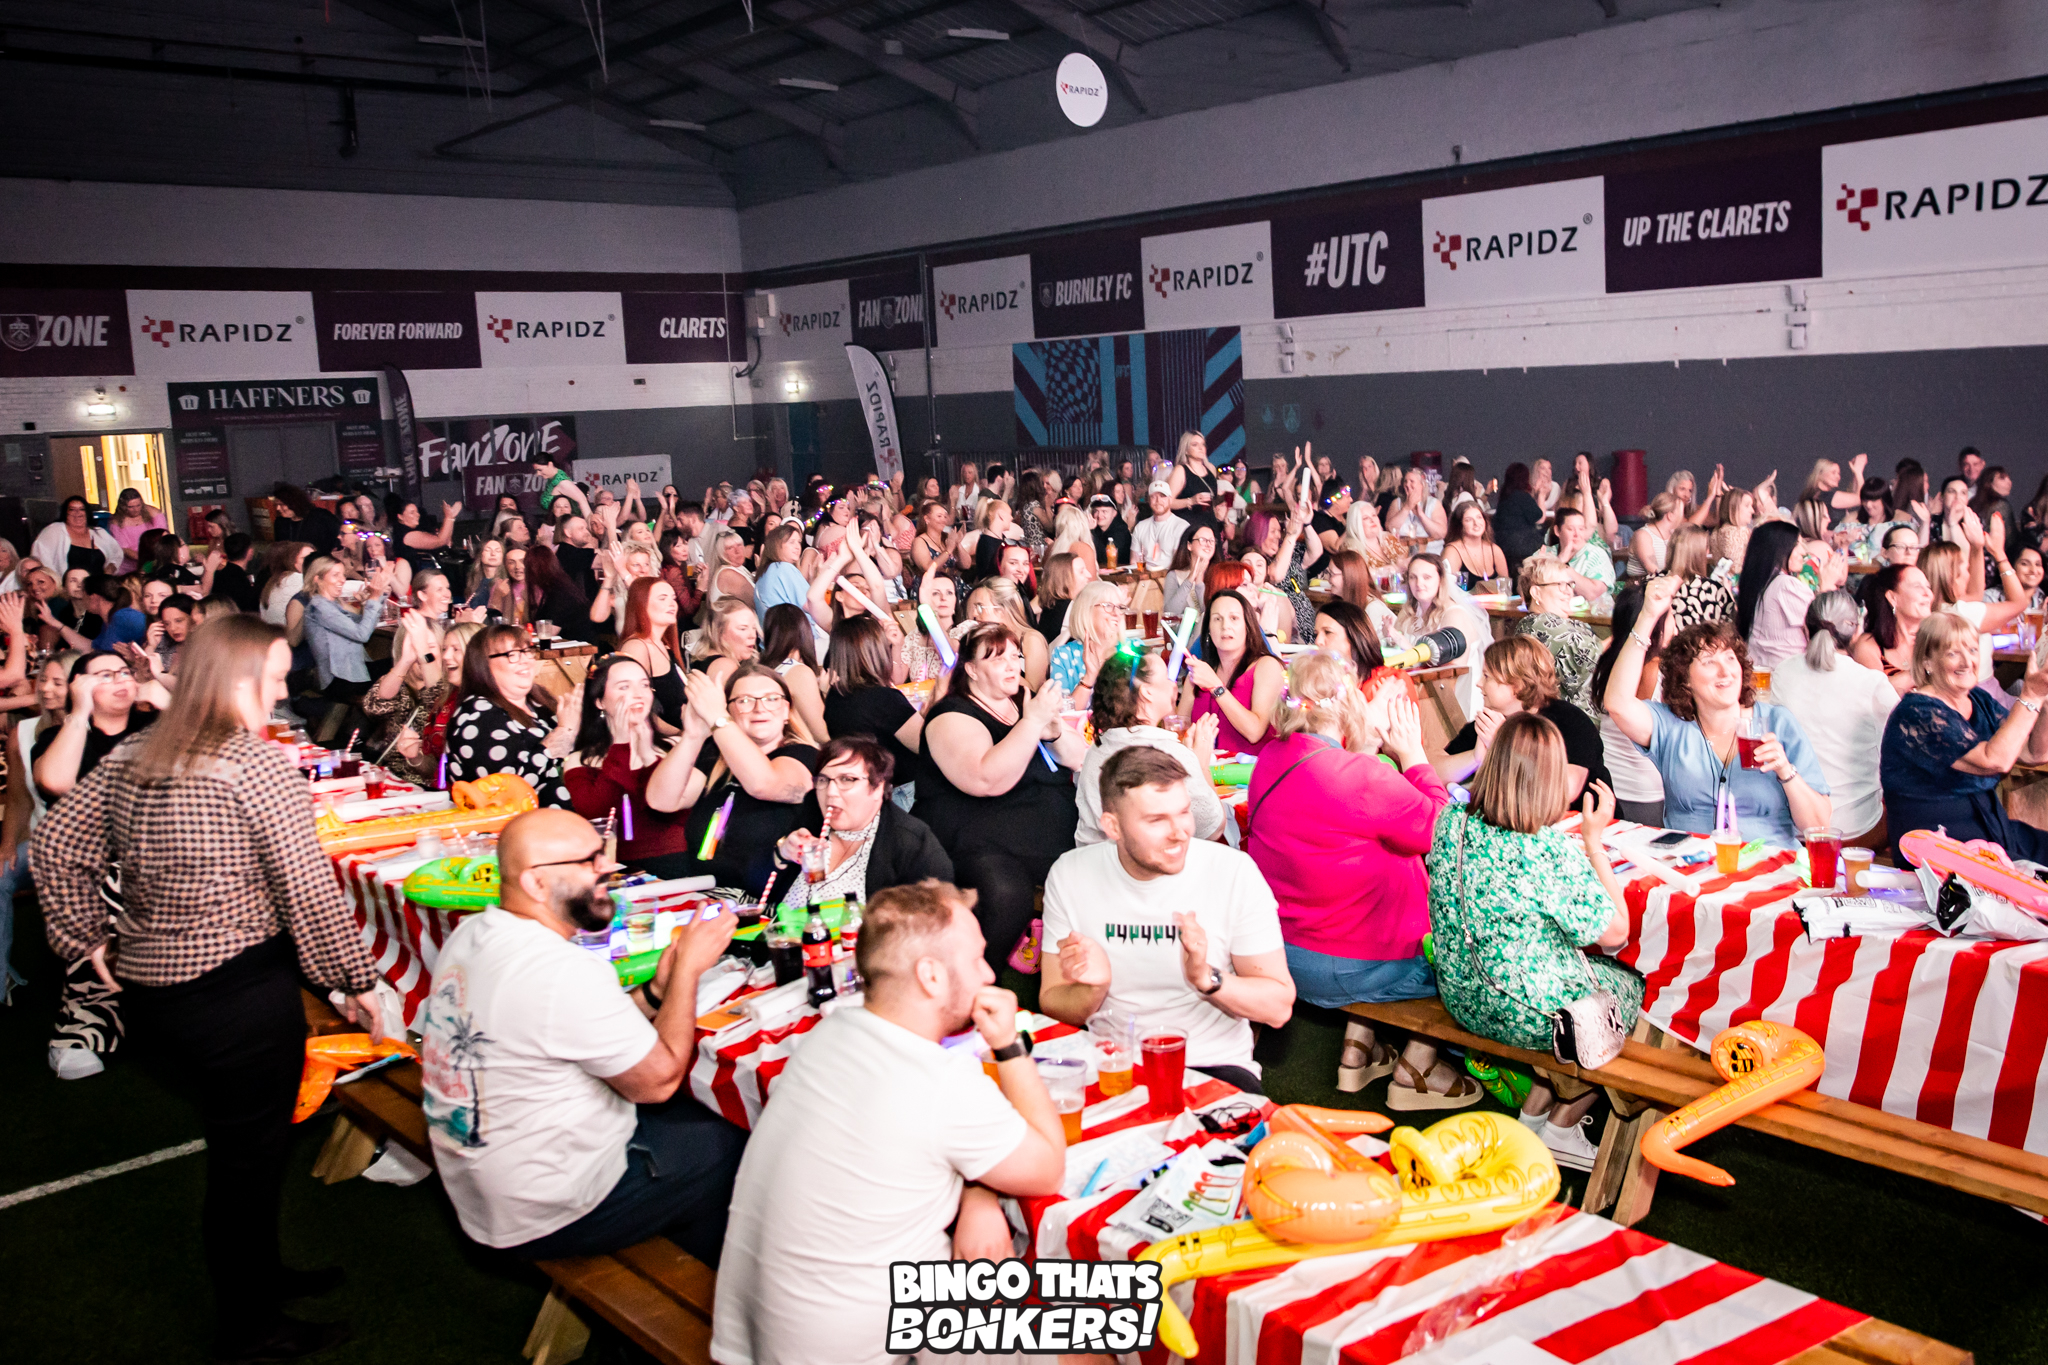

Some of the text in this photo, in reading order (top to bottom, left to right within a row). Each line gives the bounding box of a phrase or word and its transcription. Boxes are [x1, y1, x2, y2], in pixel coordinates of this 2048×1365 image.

[1068, 84, 1100, 97] RAPIDZ
[1884, 173, 2048, 221] RAPIDZ
[1622, 200, 1792, 247] UP THE CLARETS
[1466, 226, 1578, 262] RAPIDZ
[1304, 230, 1389, 289] #UTC
[1173, 262, 1254, 292] RAPIDZ
[1055, 272, 1133, 307] BURNLEY FC
[858, 299, 880, 328] FAN
[957, 290, 1019, 314] RAPIDZ
[36, 315, 110, 347] ZONE
[178, 323, 292, 343] RAPIDZ
[333, 322, 463, 341] FOREVER FORWARD
[516, 321, 606, 339] RAPIDZ
[659, 317, 726, 339] CLARETS
[792, 310, 841, 332] RAPIDZ
[208, 385, 346, 410] HAFFNERS
[475, 473, 545, 496] FAN ZO
[602, 471, 658, 486] RAPIDZ
